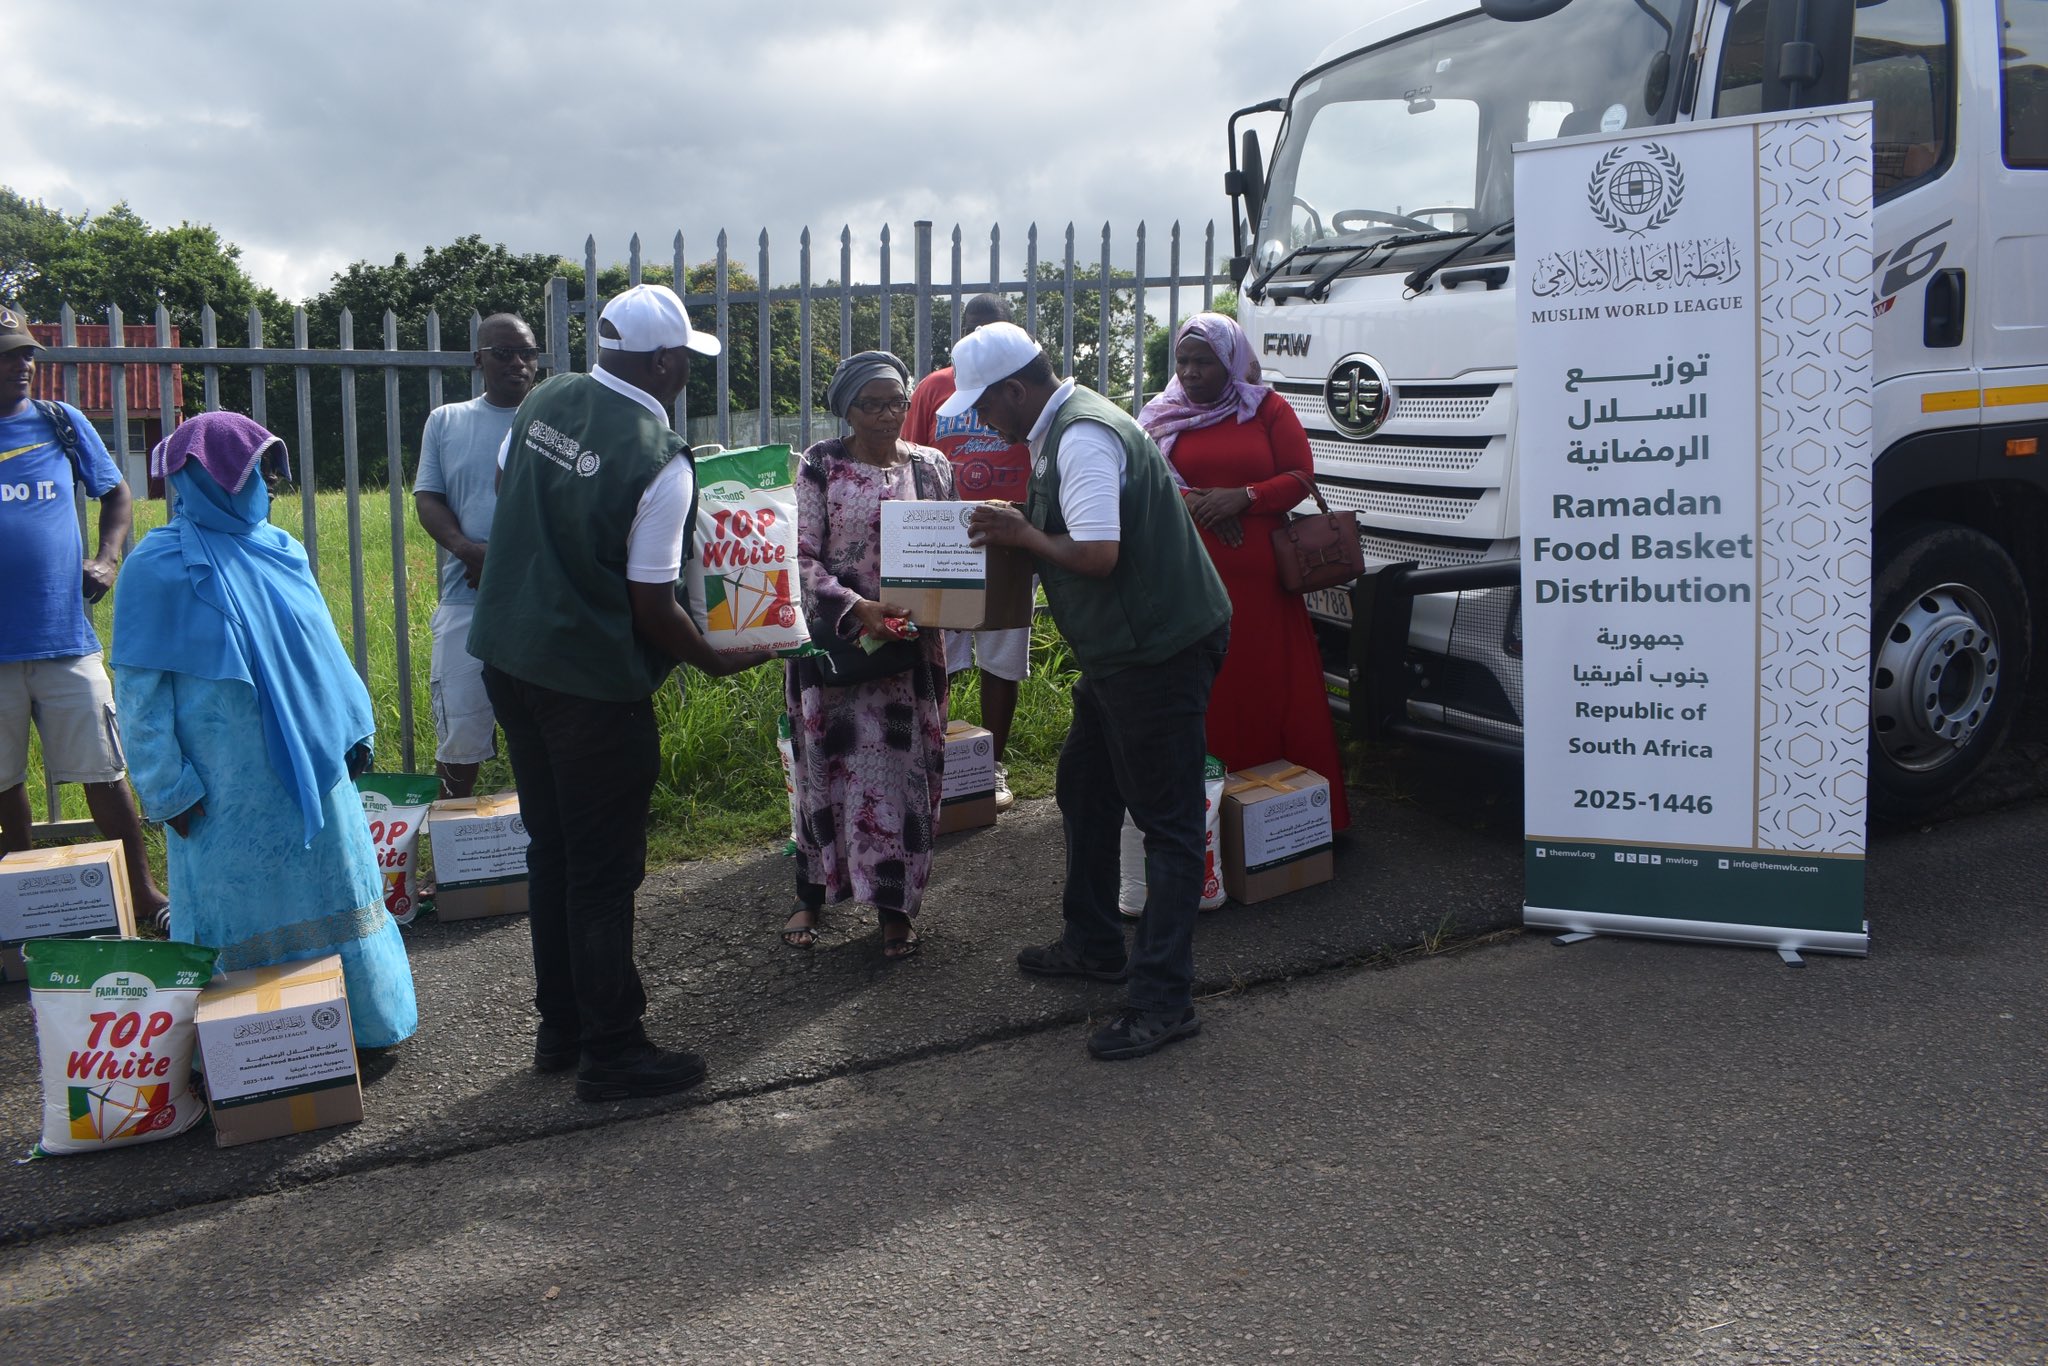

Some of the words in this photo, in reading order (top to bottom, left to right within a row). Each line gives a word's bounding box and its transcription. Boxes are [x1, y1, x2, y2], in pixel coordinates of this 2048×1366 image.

[1531, 307, 1600, 323] MUSLIM
[1604, 301, 1669, 318] WORLD
[1674, 296, 1743, 313] LEAGUE
[1263, 333, 1312, 357] FAW
[1567, 435, 1709, 472] الرمضانية
[0, 483, 30, 501] DO
[37, 480, 57, 500] IT.
[760, 478, 775, 487] TOP
[721, 490, 745, 501] FOODS
[1552, 488, 1722, 519] Ramadan
[711, 508, 776, 540] TOP
[703, 540, 785, 568] White
[1533, 533, 1620, 562] Food
[1631, 531, 1753, 560] Basket
[1535, 576, 1751, 604] Distribution
[771, 640, 799, 650] Shines
[1596, 627, 1684, 651] جمهورية
[1573, 658, 1644, 687] أفريقيا
[1650, 666, 1709, 689] جنوب
[1575, 701, 1674, 722] Republic
[1681, 703, 1707, 720] of
[1568, 737, 1636, 755] South
[1642, 739, 1713, 758] Africa
[1573, 789, 1713, 815] 2025-1446
[369, 820, 408, 846] OP
[1549, 849, 1596, 860] themwl.org
[1665, 857, 1699, 867] mwlorg
[1732, 860, 1819, 874] info@themwlx.com
[49, 971, 64, 985] kg
[66, 974, 80, 985] 10
[176, 977, 195, 985] TOP
[95, 986, 119, 998] FARM
[121, 986, 148, 998] FOODS
[87, 1011, 173, 1050] TOP
[235, 1038, 260, 1047] MUSLIM
[260, 1034, 284, 1043] WORLD
[284, 1030, 307, 1038] LEAGUE
[66, 1050, 171, 1080] White
[239, 1062, 270, 1071] Ramadan
[287, 1054, 309, 1063] Basket
[310, 1048, 348, 1058] Distribution
